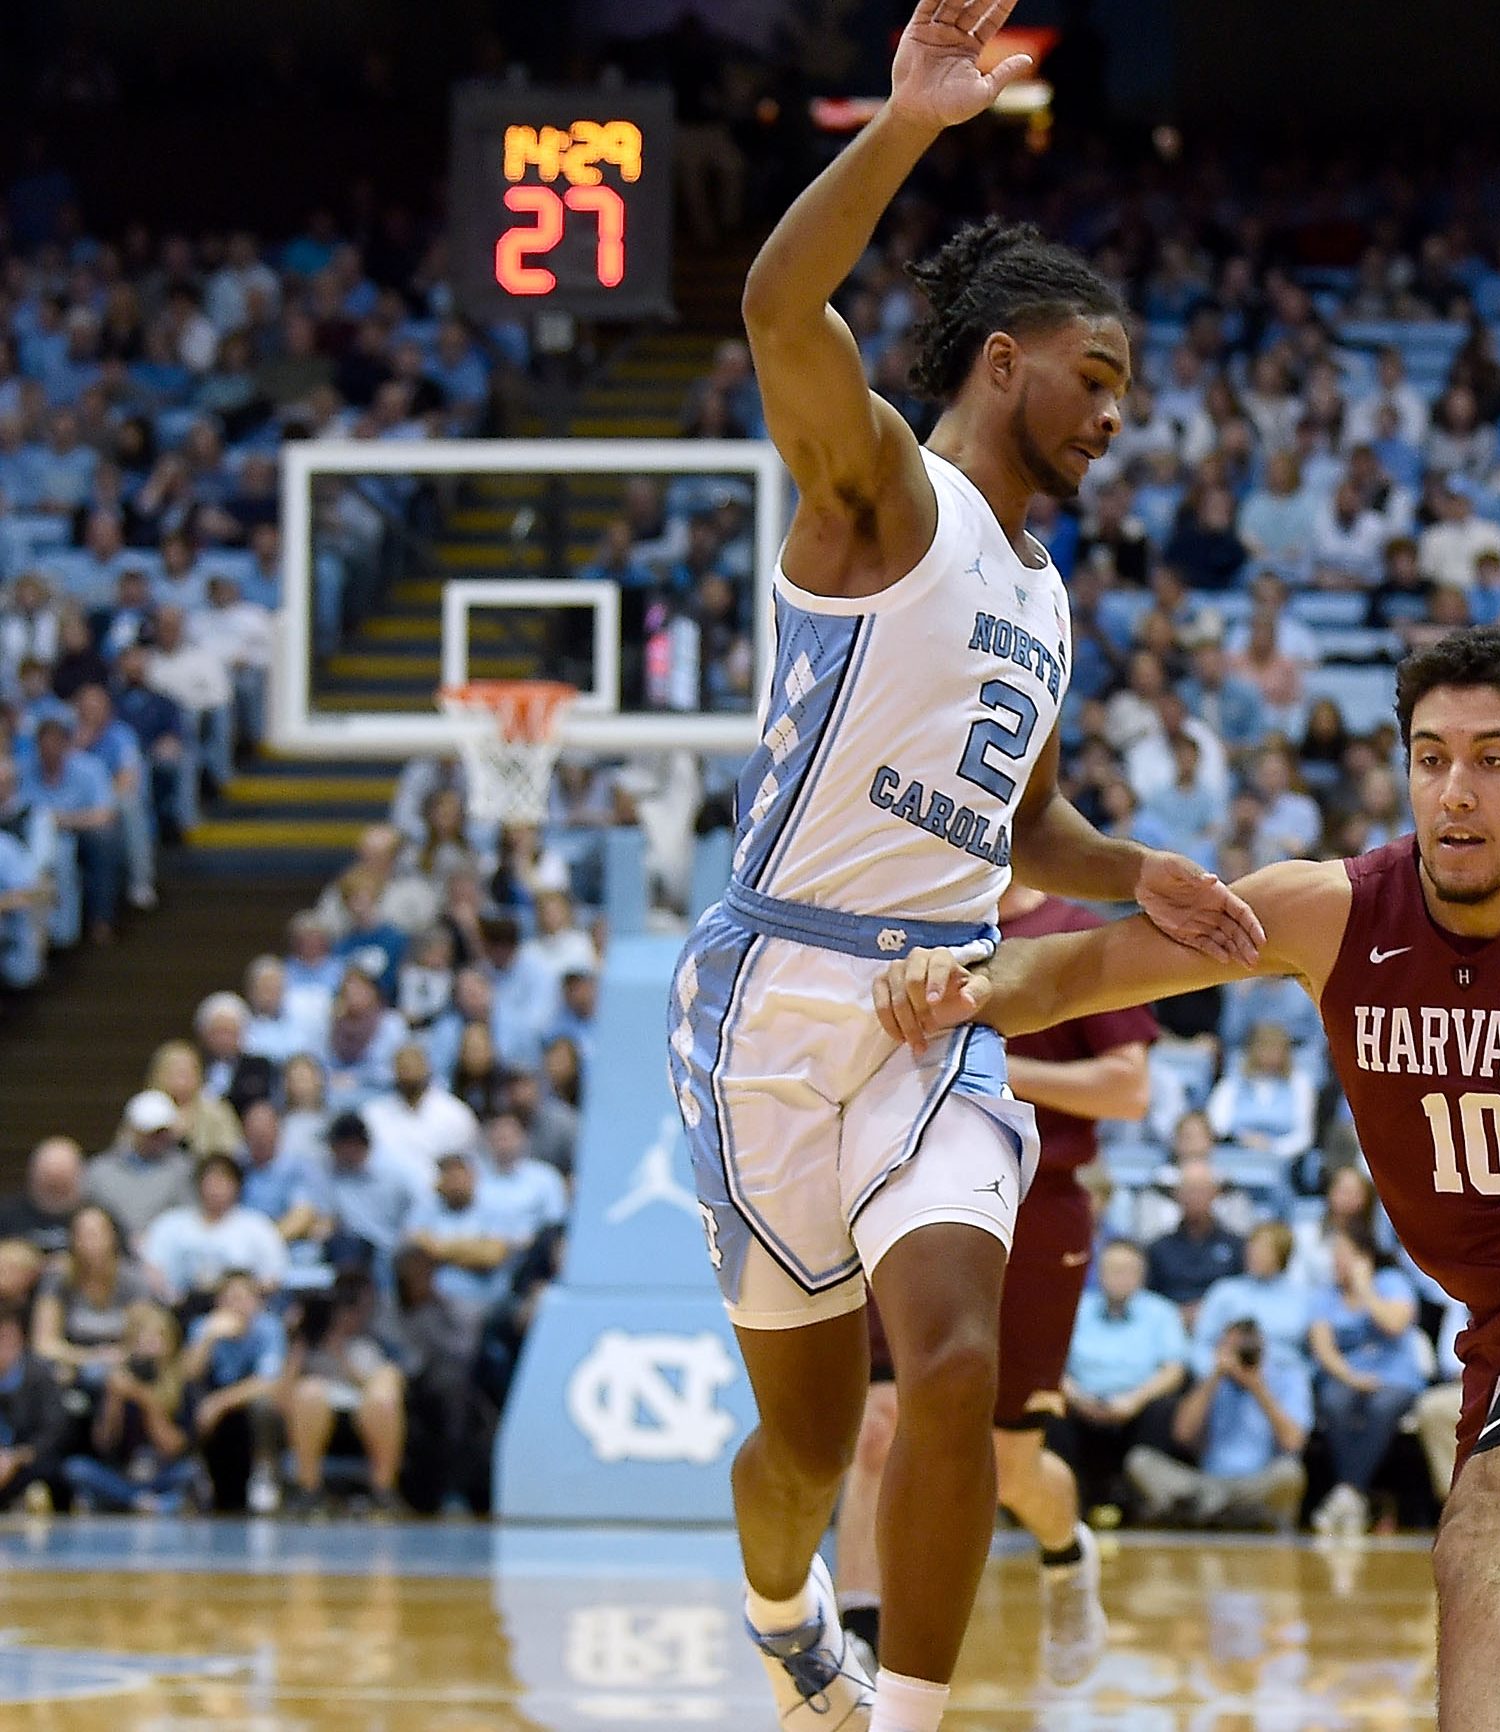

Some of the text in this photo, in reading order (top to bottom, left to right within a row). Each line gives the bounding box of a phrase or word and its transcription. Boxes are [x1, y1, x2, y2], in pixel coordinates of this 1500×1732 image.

[504, 120, 643, 185] 14:29
[496, 185, 625, 295] 27
[968, 611, 1061, 705] NORTH
[956, 679, 1039, 805] 2
[1458, 969, 1470, 984] H
